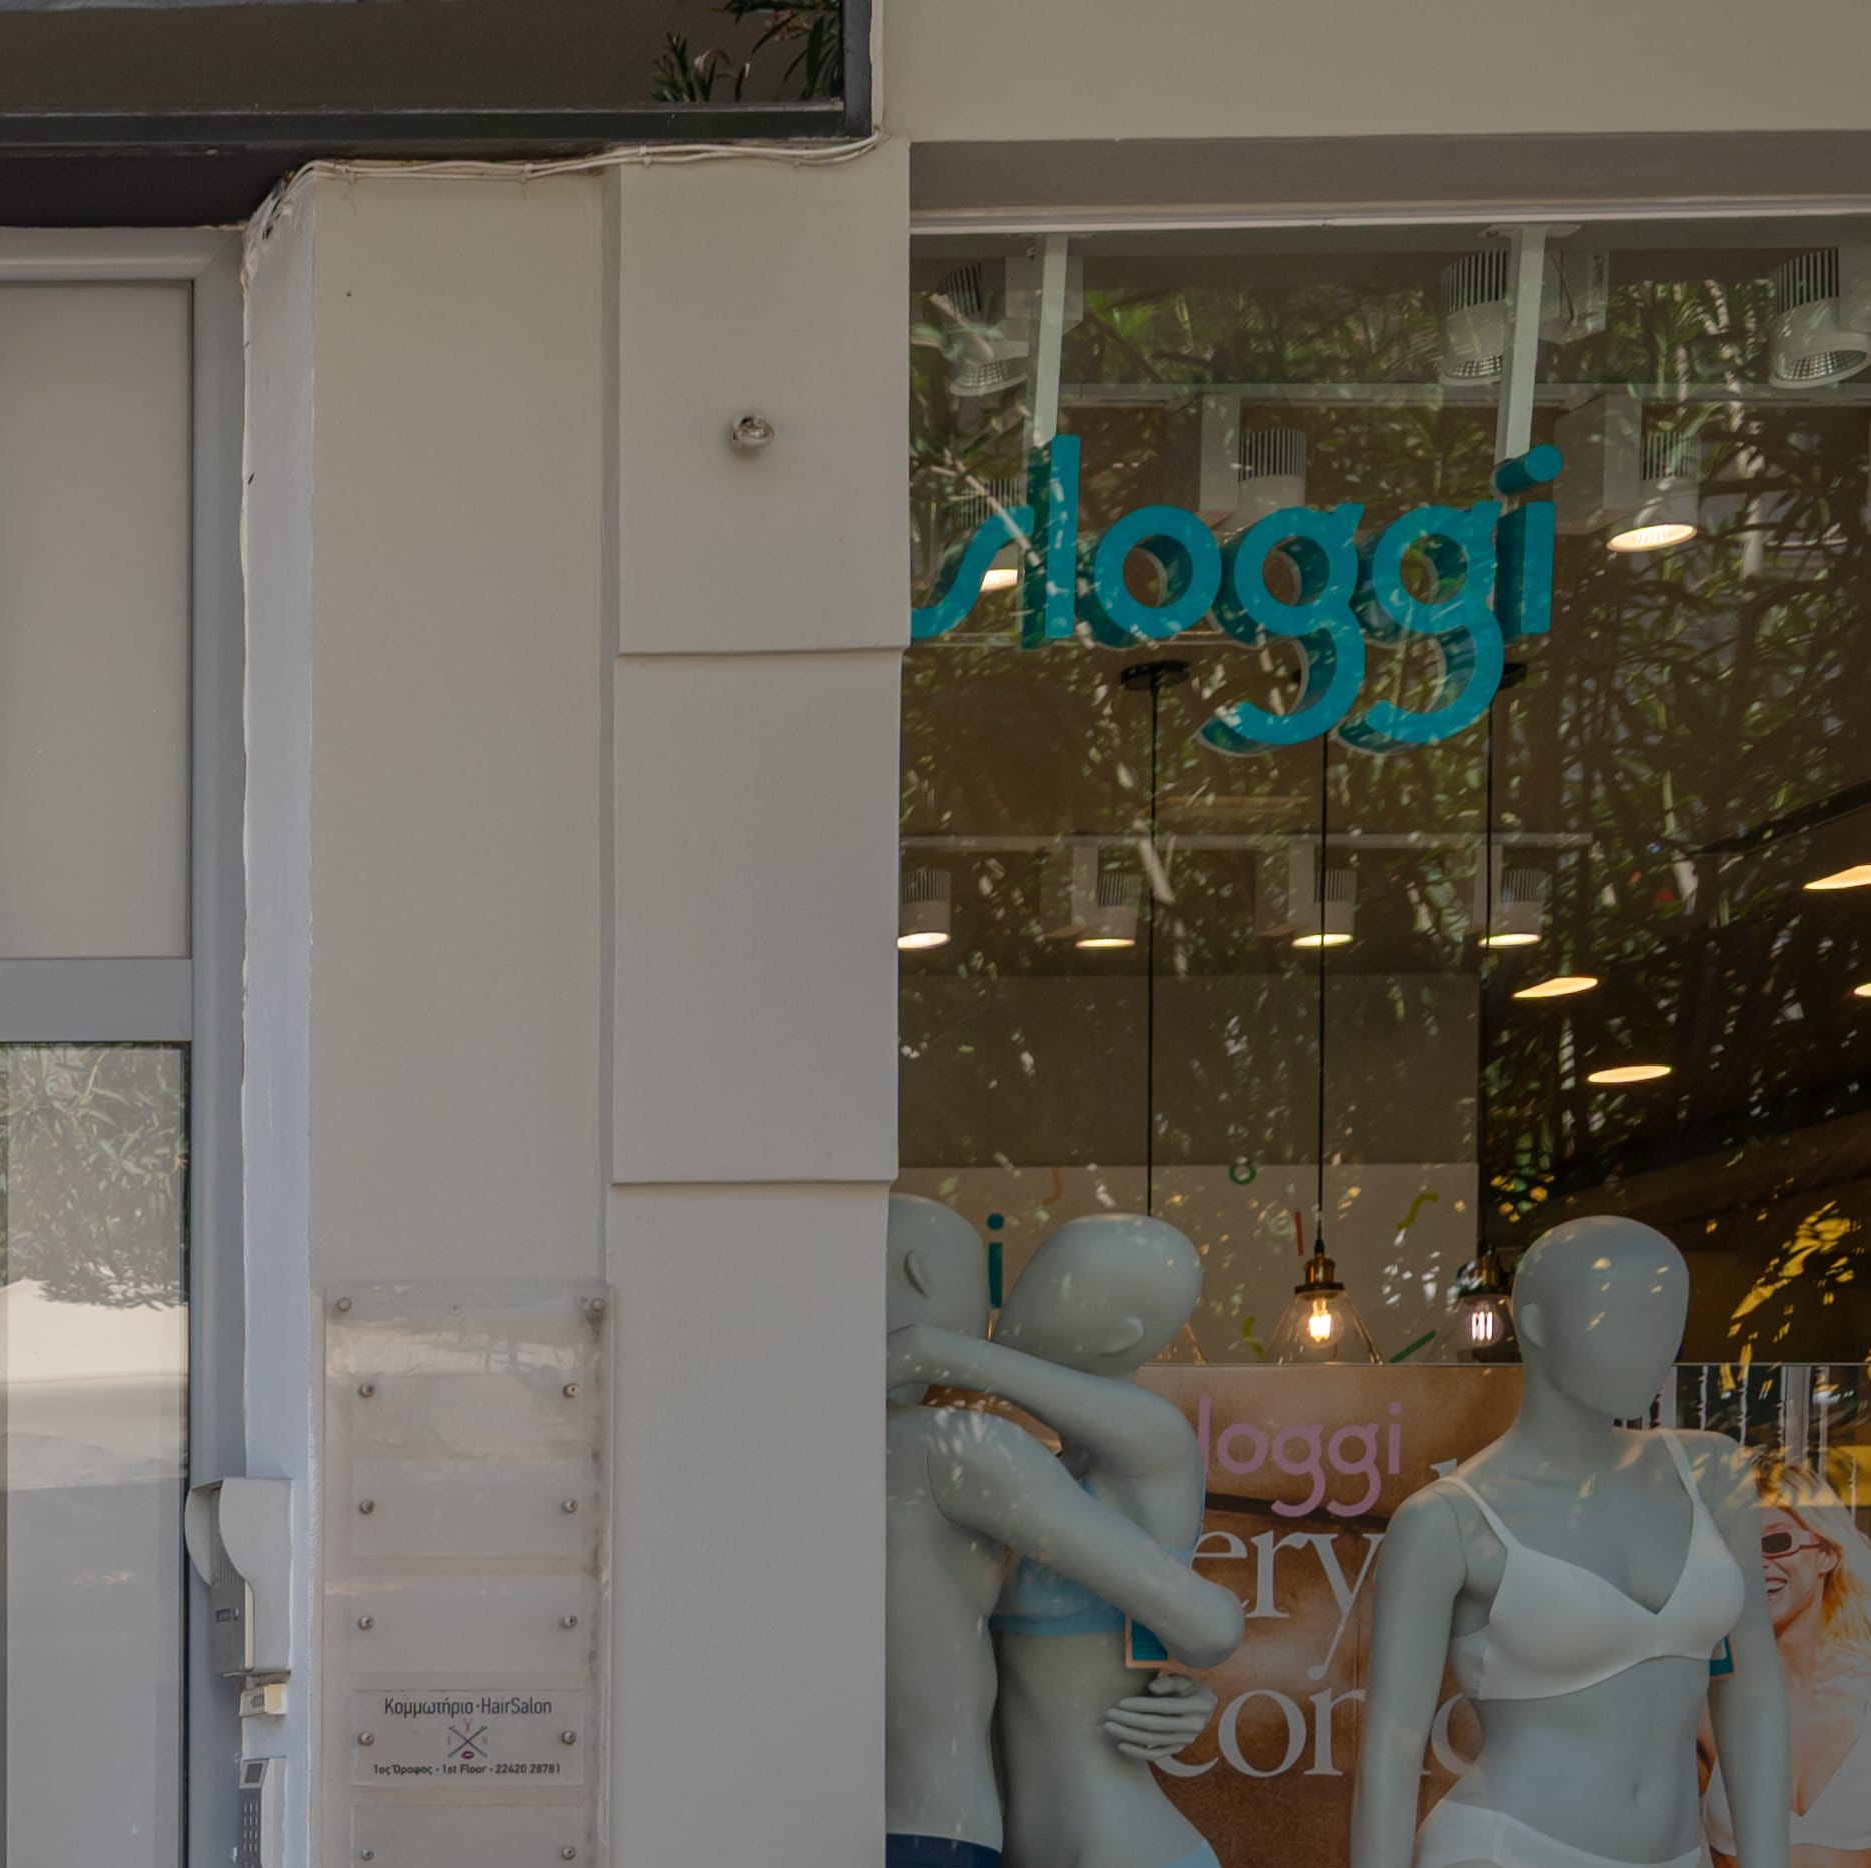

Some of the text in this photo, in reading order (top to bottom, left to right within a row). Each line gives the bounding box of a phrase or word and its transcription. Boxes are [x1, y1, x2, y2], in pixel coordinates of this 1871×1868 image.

[911, 434, 1564, 756] sloggi
[1197, 1395, 1405, 1519] loggi
[384, 1697, 552, 1718] Κομμωτήριο HairSalon
[442, 1764, 457, 1774] 1st
[460, 1764, 486, 1774] Floor
